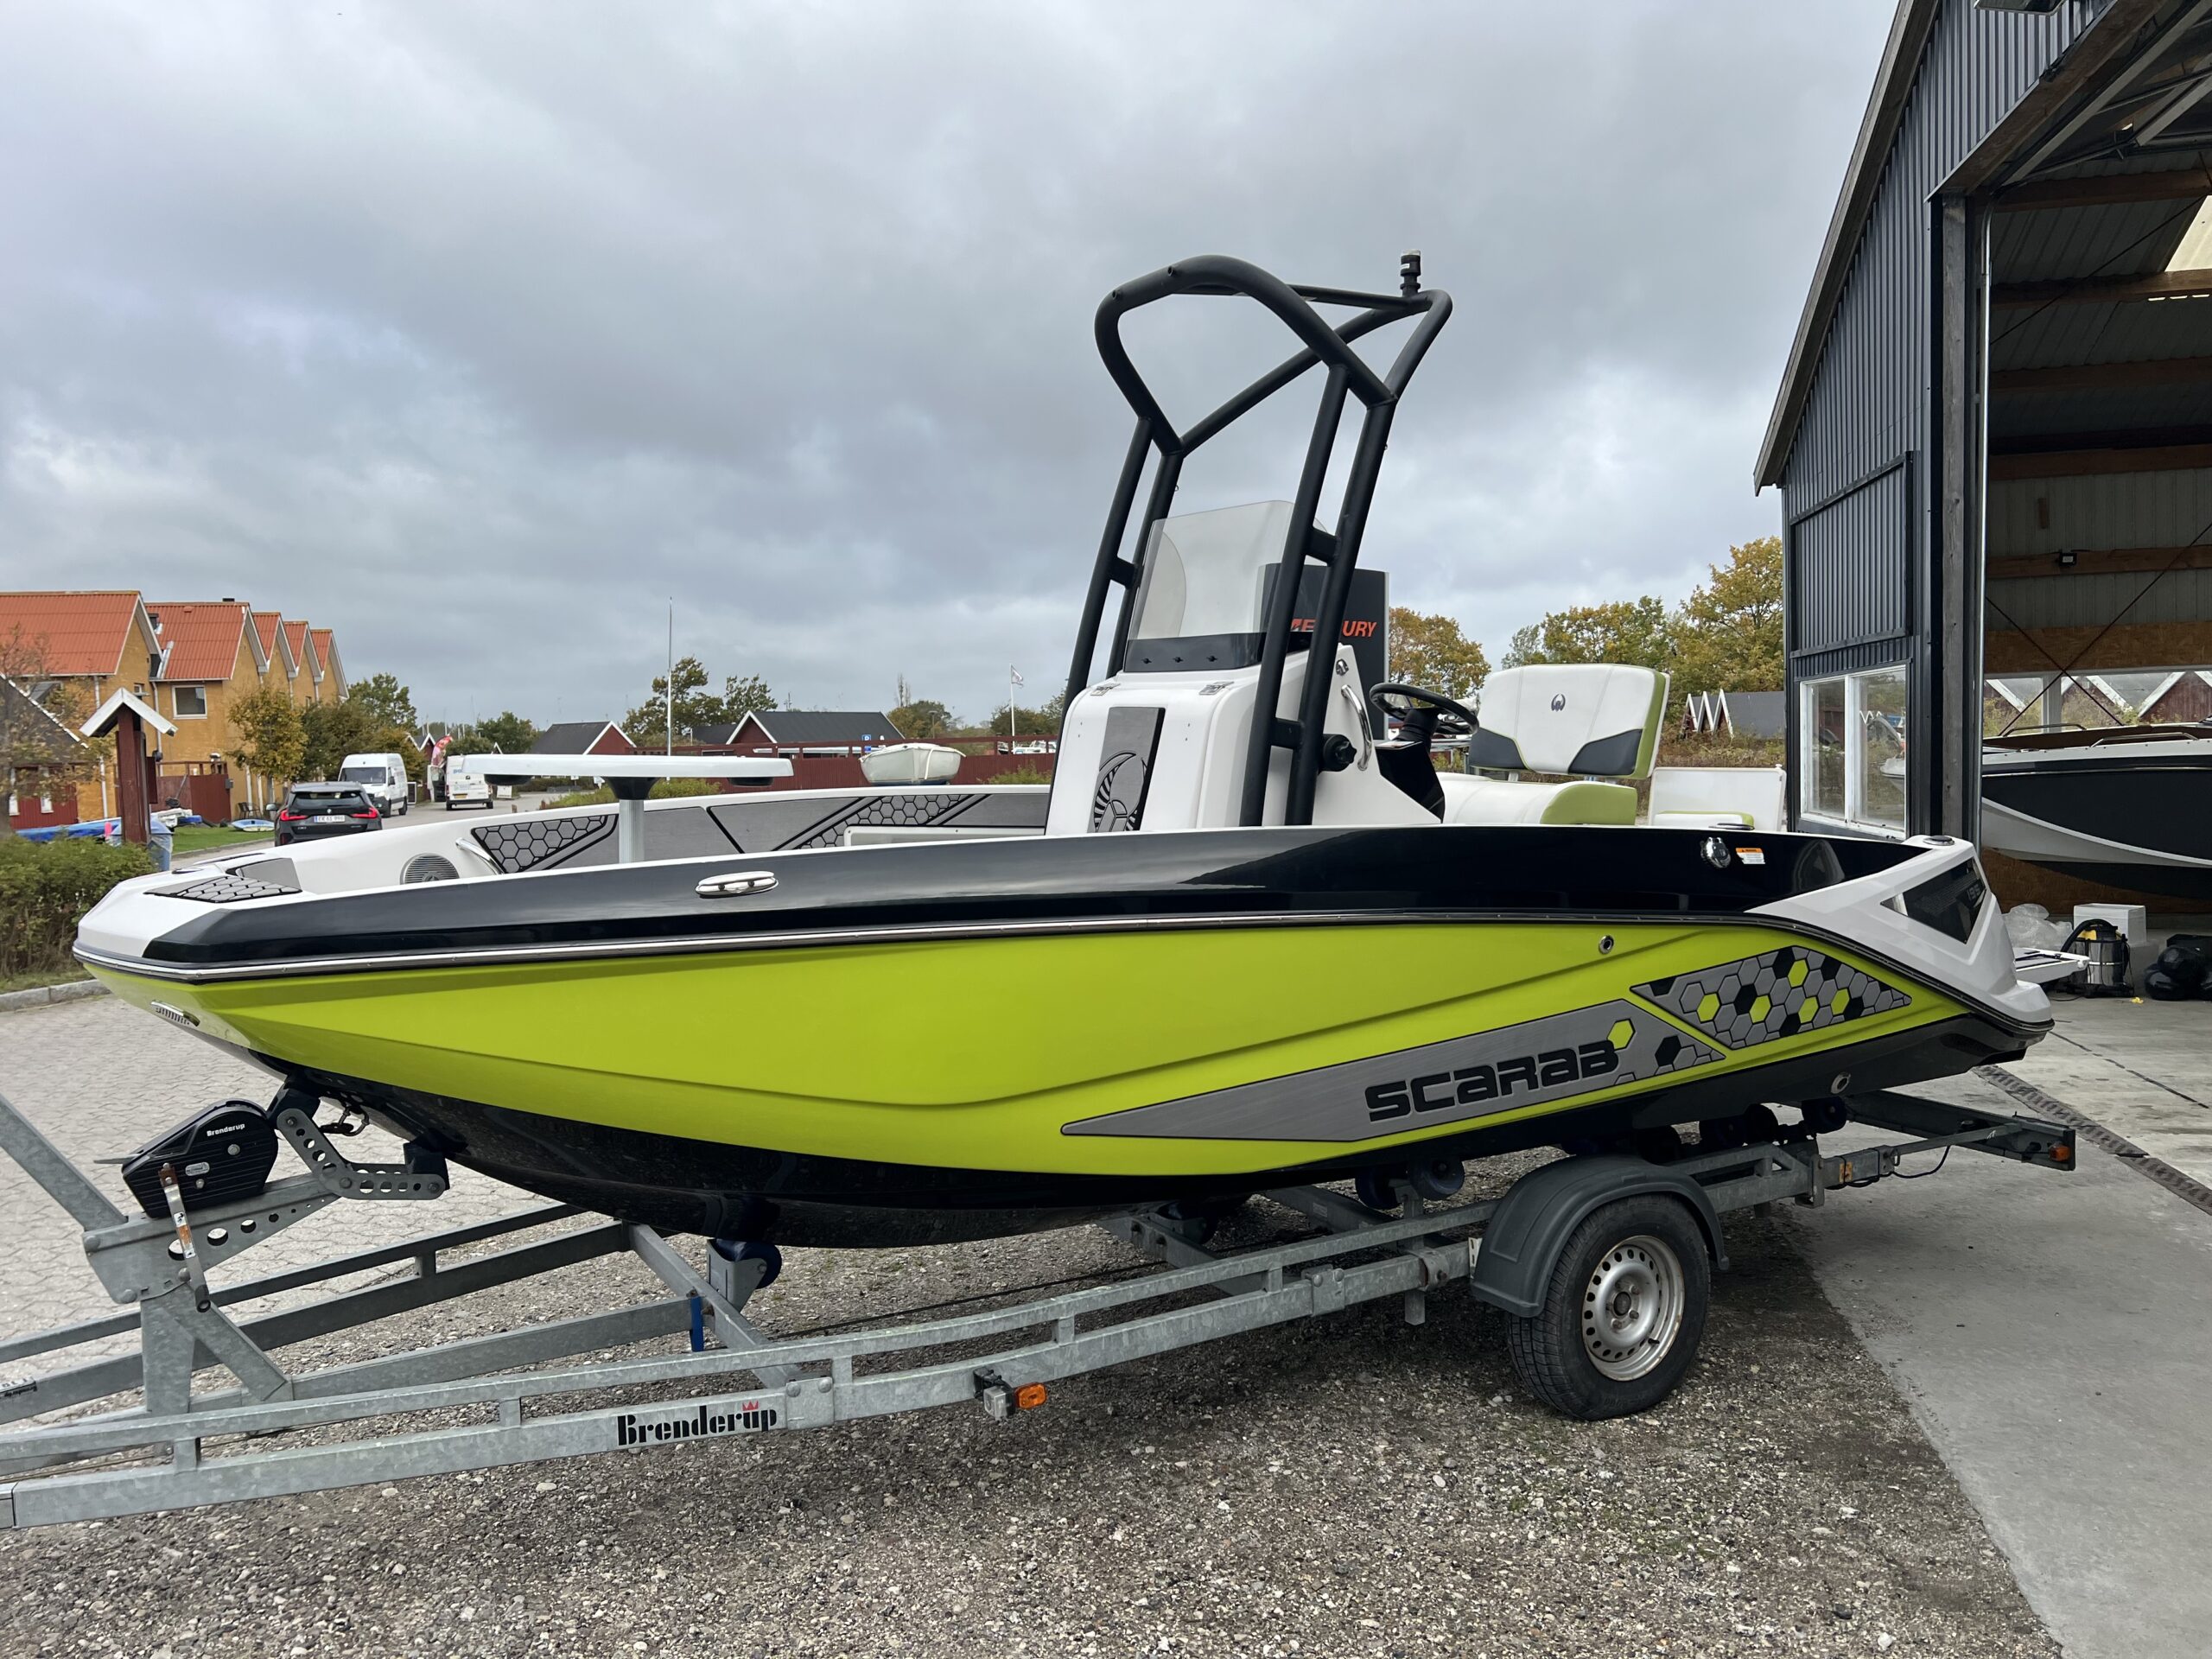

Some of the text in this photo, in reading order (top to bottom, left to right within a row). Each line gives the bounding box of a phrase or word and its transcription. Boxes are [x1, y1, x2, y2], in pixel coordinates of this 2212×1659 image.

[1291, 618, 1377, 638] EURY
[1364, 1039, 1619, 1122] SCARAB
[207, 1123, 245, 1136] Brenderup
[617, 1405, 778, 1446] Brenderup
